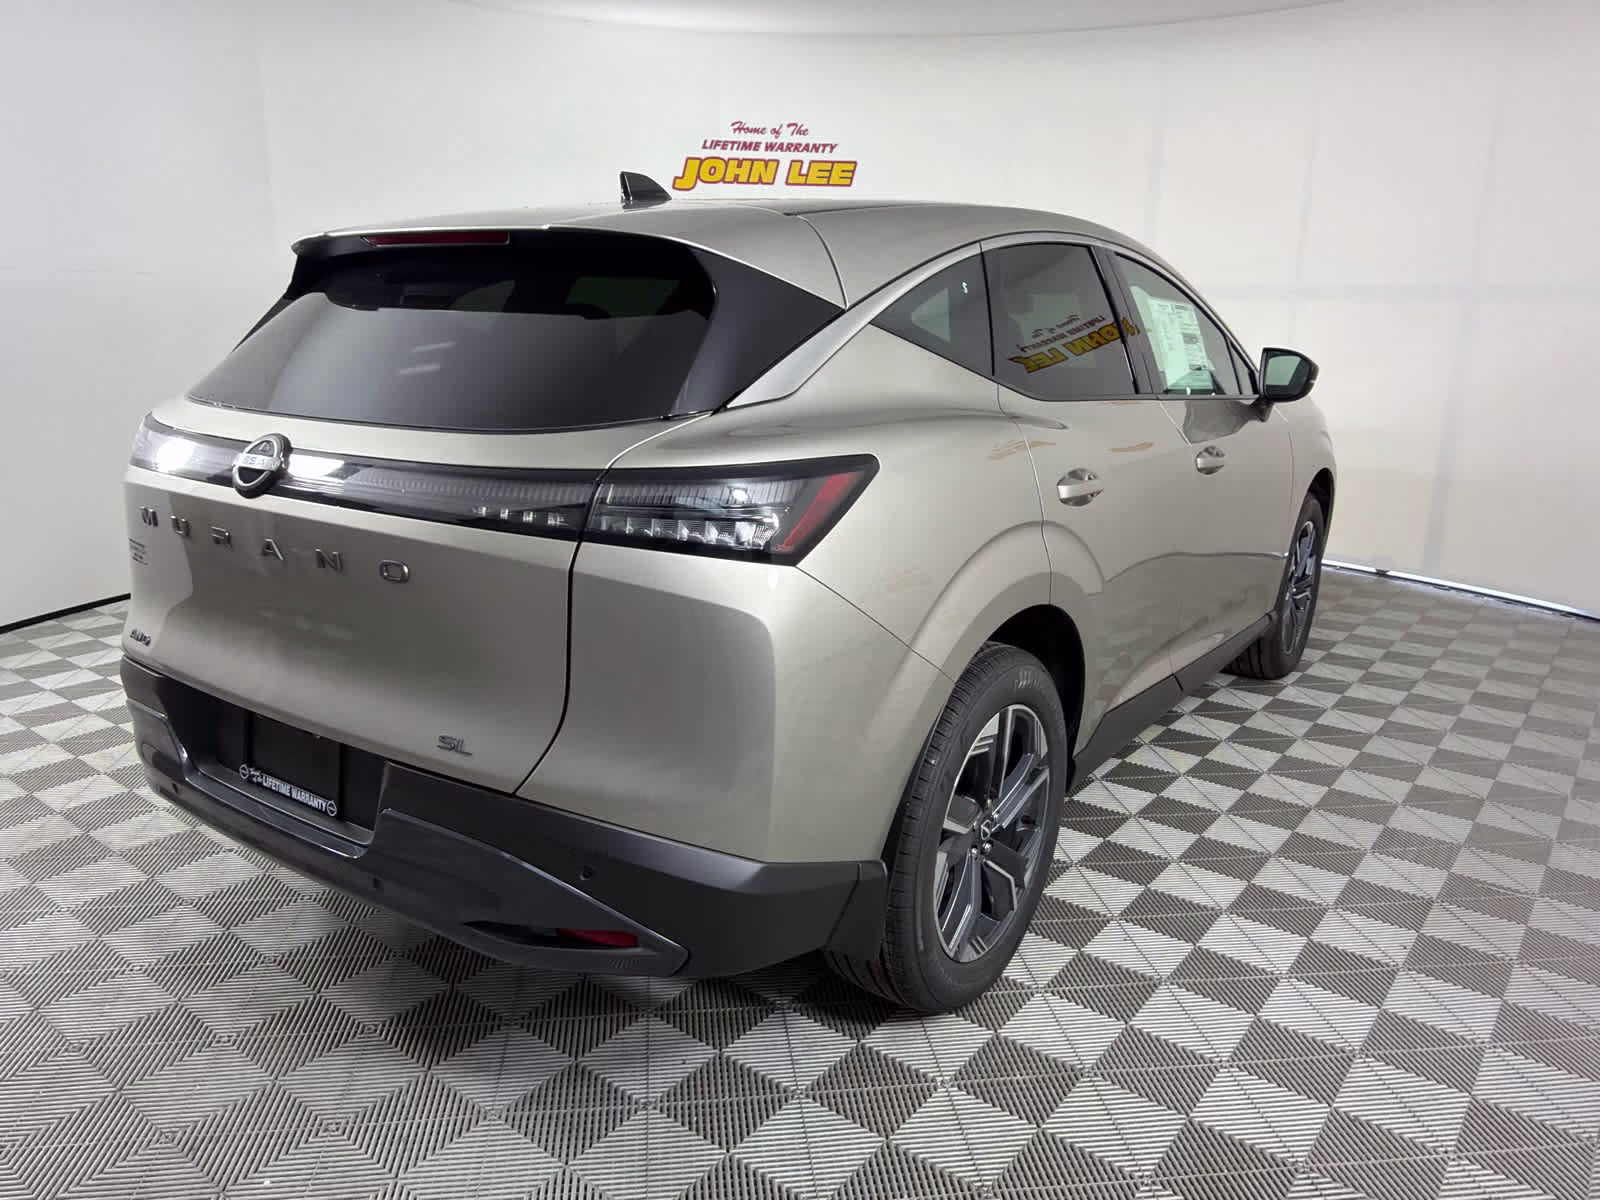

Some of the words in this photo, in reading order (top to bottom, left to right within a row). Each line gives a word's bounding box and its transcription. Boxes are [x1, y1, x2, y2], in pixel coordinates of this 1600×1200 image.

[730, 120, 767, 136] Home
[769, 124, 783, 139] of
[786, 123, 809, 137] The
[701, 139, 762, 152] LIFETIME
[764, 142, 838, 154] WARRANTY
[672, 156, 780, 191] JOHN
[785, 159, 858, 188] LEE
[139, 505, 410, 584] MURANO
[436, 735, 473, 756] SL
[262, 774, 291, 797] LIFETIME
[291, 785, 326, 812] WARRANTY
